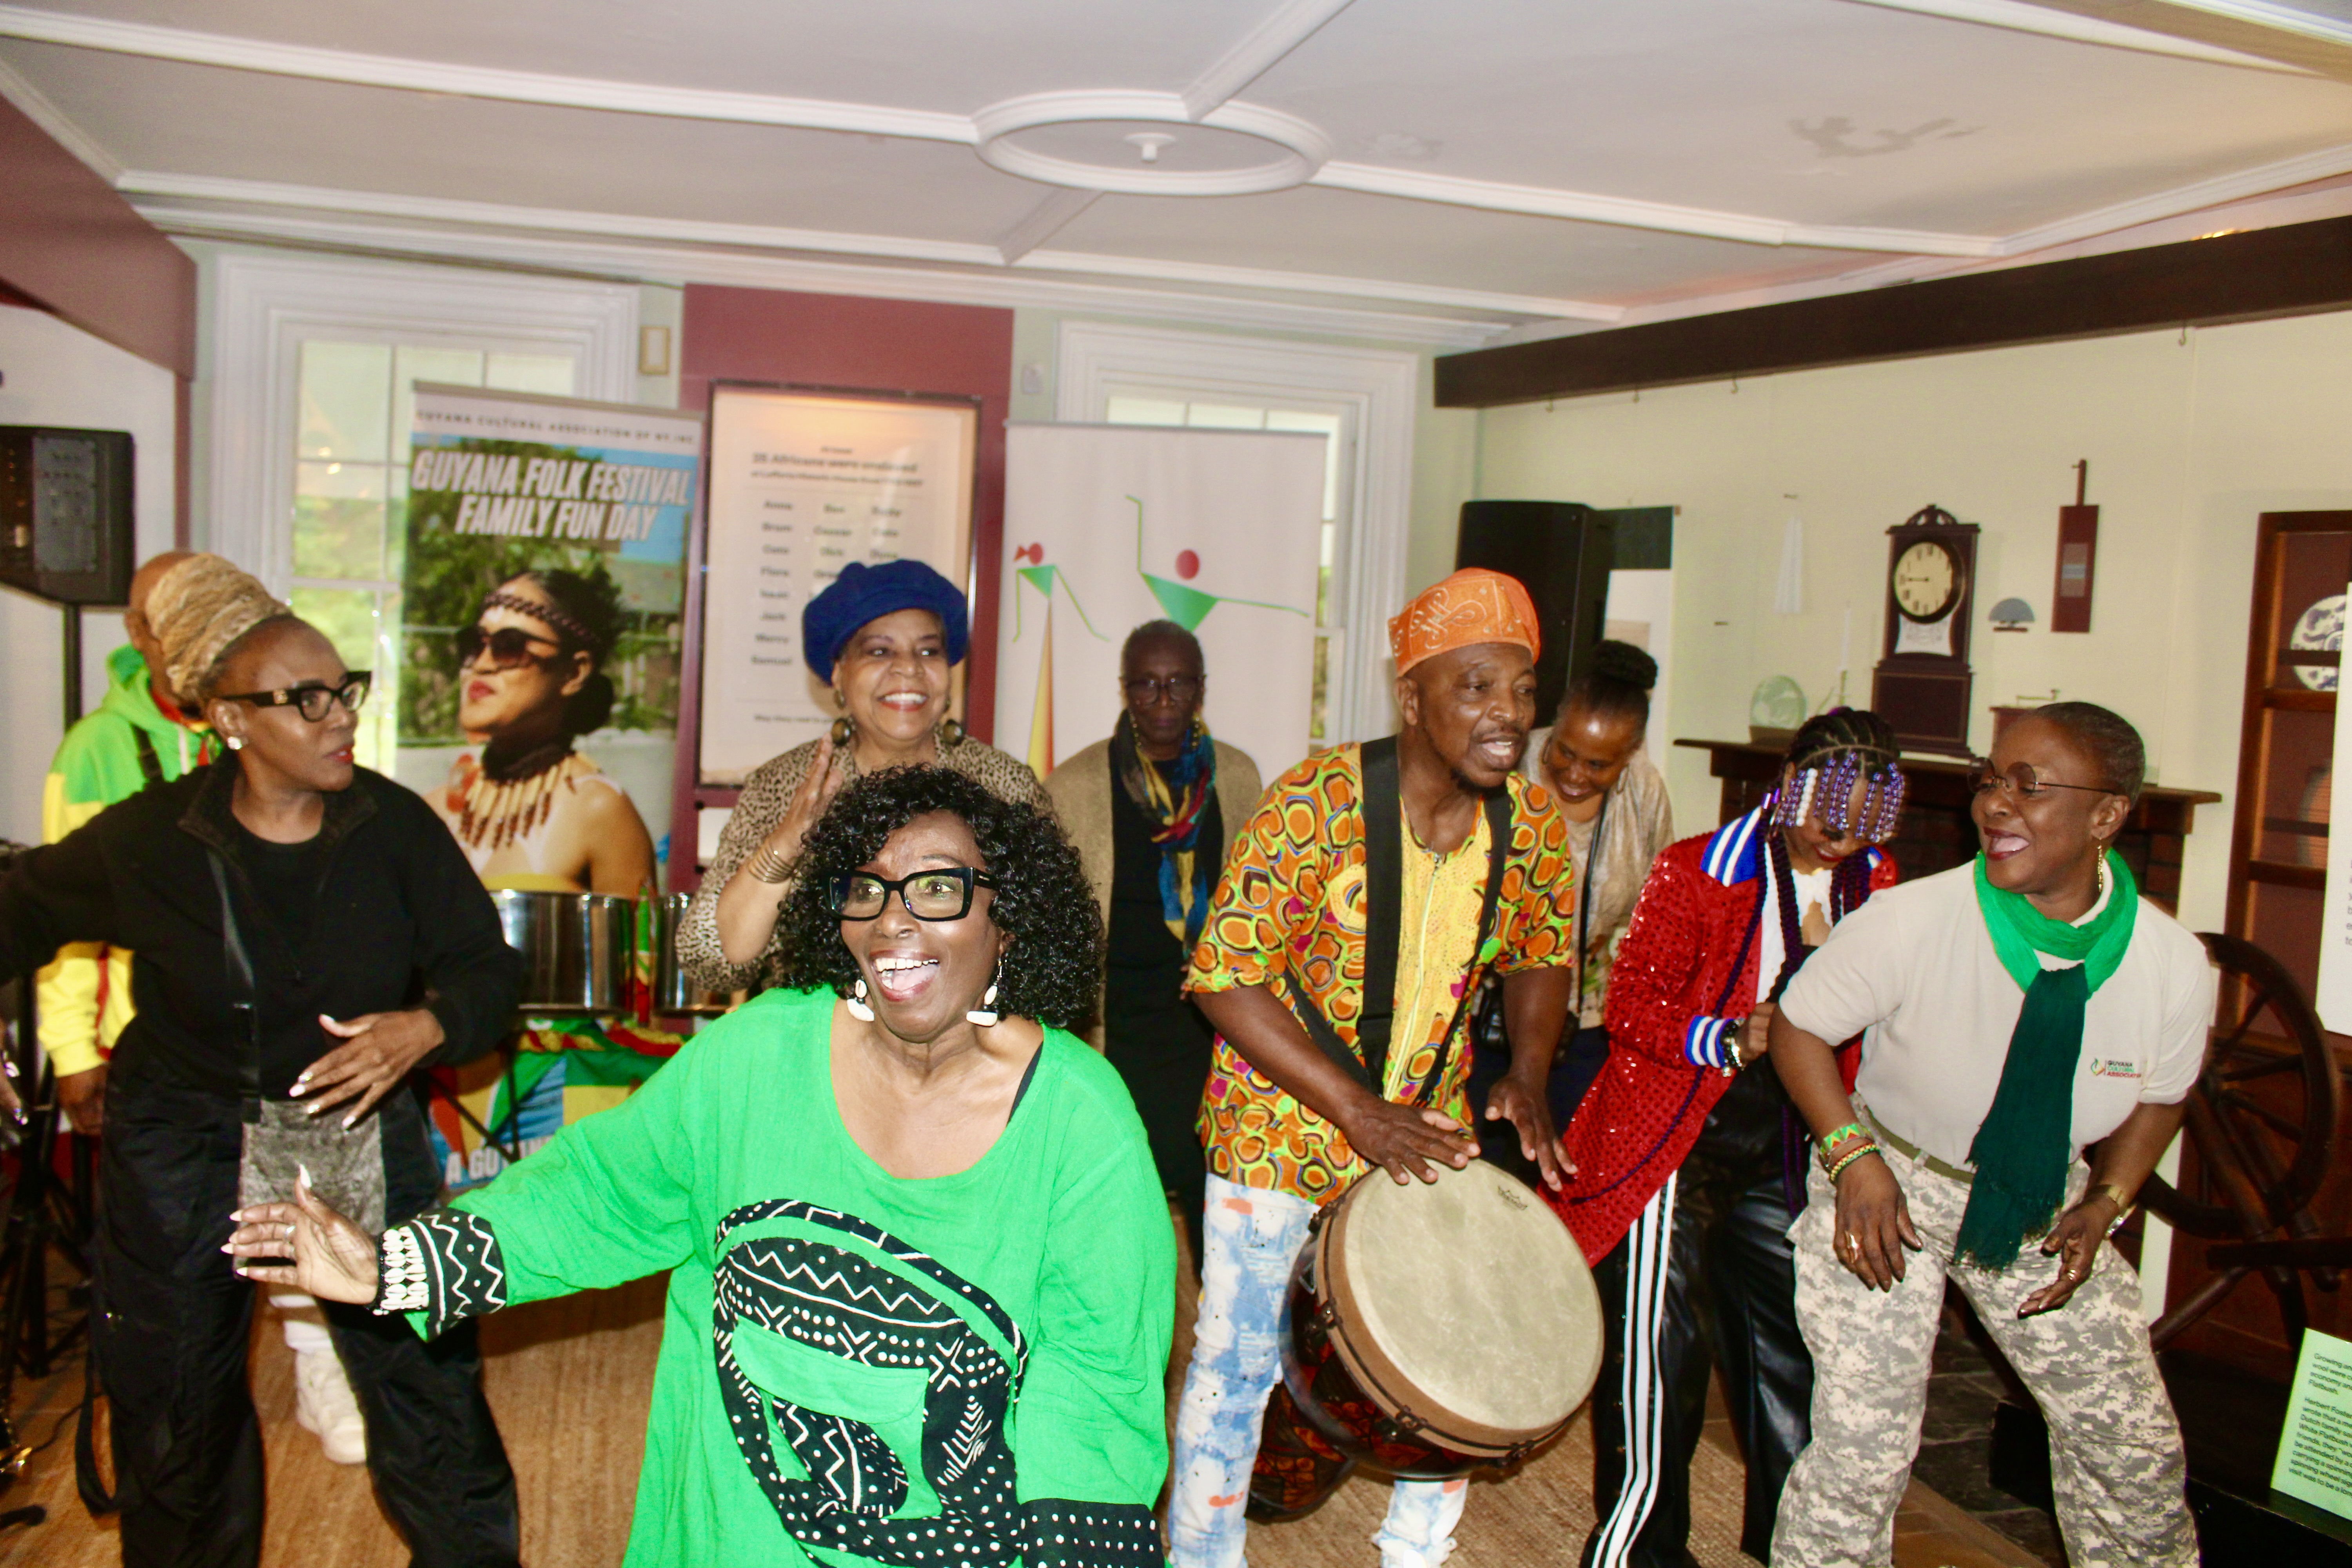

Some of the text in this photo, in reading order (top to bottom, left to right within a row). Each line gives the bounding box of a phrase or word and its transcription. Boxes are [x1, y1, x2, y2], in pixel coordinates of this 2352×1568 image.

[416, 411, 472, 423] GUYANA
[477, 416, 542, 430] CULTURAL
[550, 423, 630, 438] ASSOCIATION
[635, 431, 649, 439] OF
[412, 450, 691, 506] GUYANA FOLK FESTIVAL
[454, 494, 660, 542] FAMILY FUN DAY
[445, 1151, 462, 1185] A
[2312, 1363, 2346, 1378] wool were
[2314, 1353, 2342, 1368] Growing
[2310, 1372, 2341, 1387] economy
[2303, 1406, 2321, 1417] wrote
[2323, 1413, 2336, 1423] that
[2305, 1396, 2330, 1411] Herbert
[2299, 1422, 2348, 1447] White Flatbush
[2301, 1414, 2320, 1426] Dutch
[2322, 1422, 2341, 1435] family
[2294, 1440, 2303, 1448] be
[2304, 1445, 2335, 1461] attended
[2335, 1456, 2344, 1465] by
[2322, 1441, 2337, 1452] they
[2293, 1450, 2320, 1466] carrying
[2289, 1467, 2302, 1476] visit
[2303, 1473, 2316, 1482] was
[2325, 1480, 2335, 1490] be
[2290, 1459, 2319, 1474] spinning
[2320, 1470, 2341, 1483] wheel
